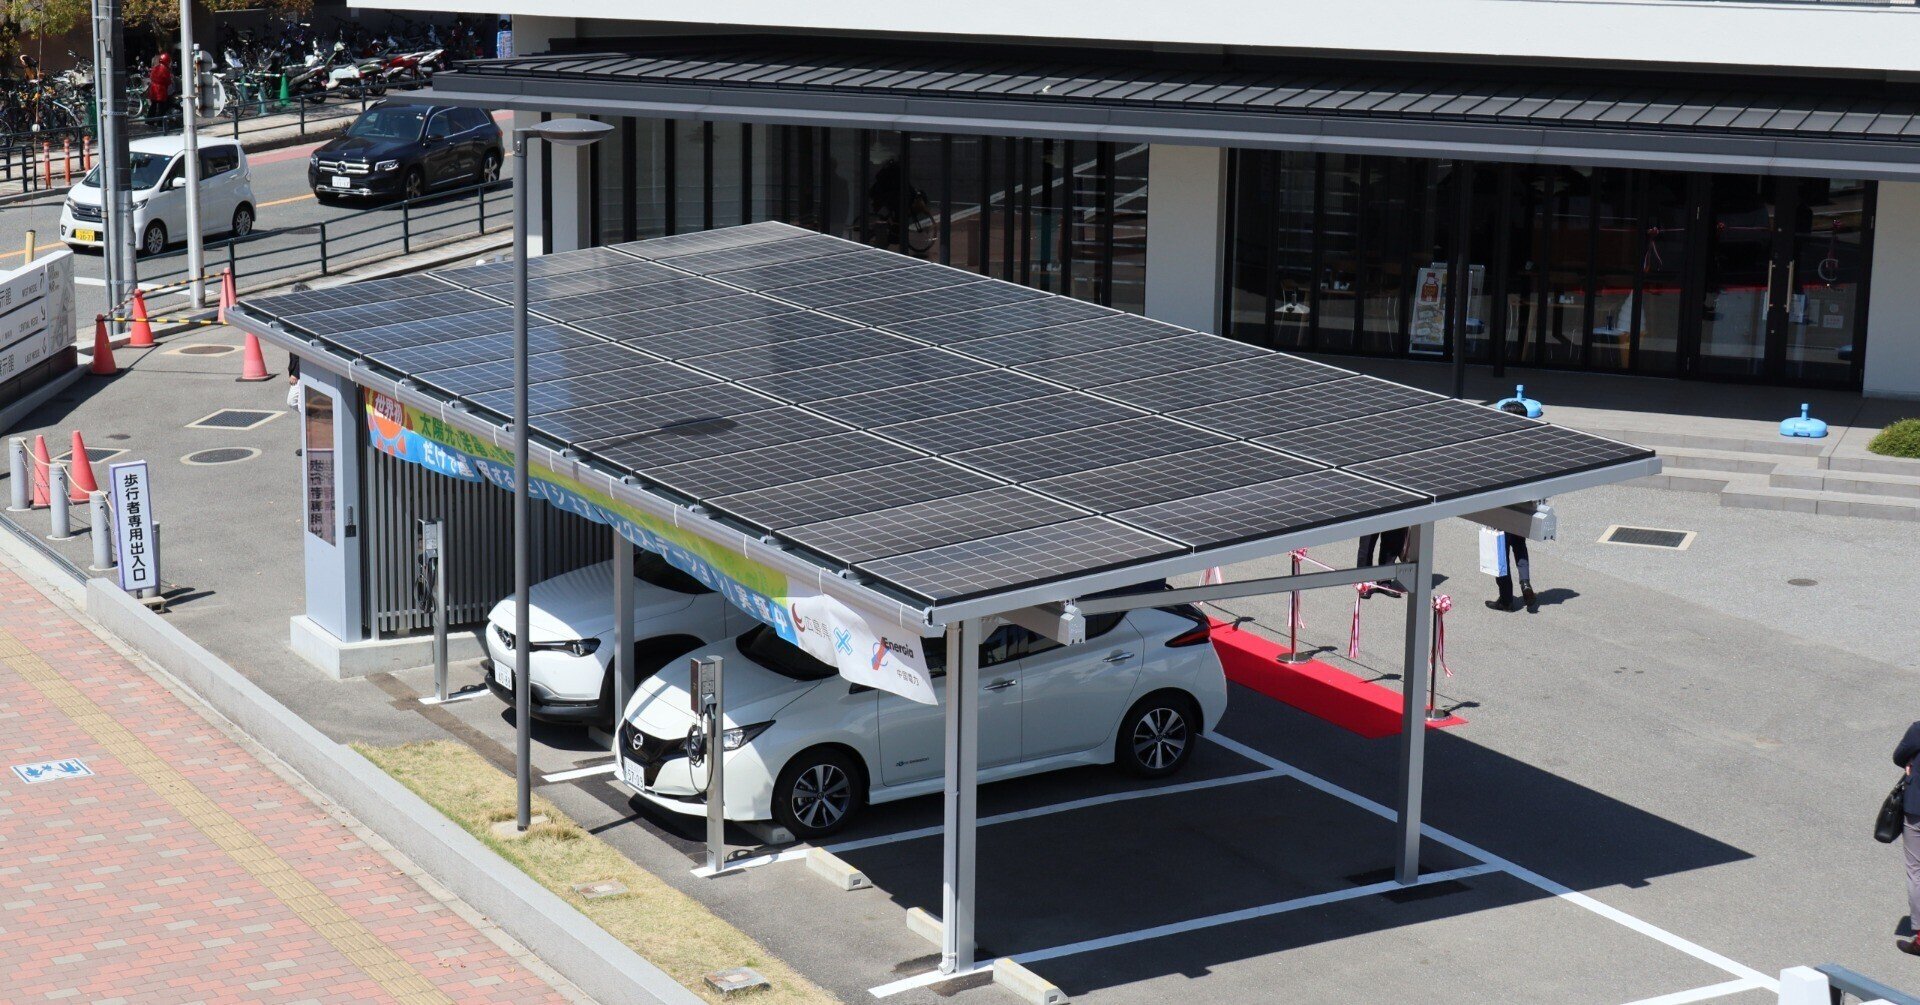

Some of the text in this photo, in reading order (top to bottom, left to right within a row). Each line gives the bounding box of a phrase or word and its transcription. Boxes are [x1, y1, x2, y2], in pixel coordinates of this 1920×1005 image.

[375, 393, 403, 425] 世界初
[123, 473, 146, 582] 歩行者専用出入口
[884, 637, 914, 659] Energia
